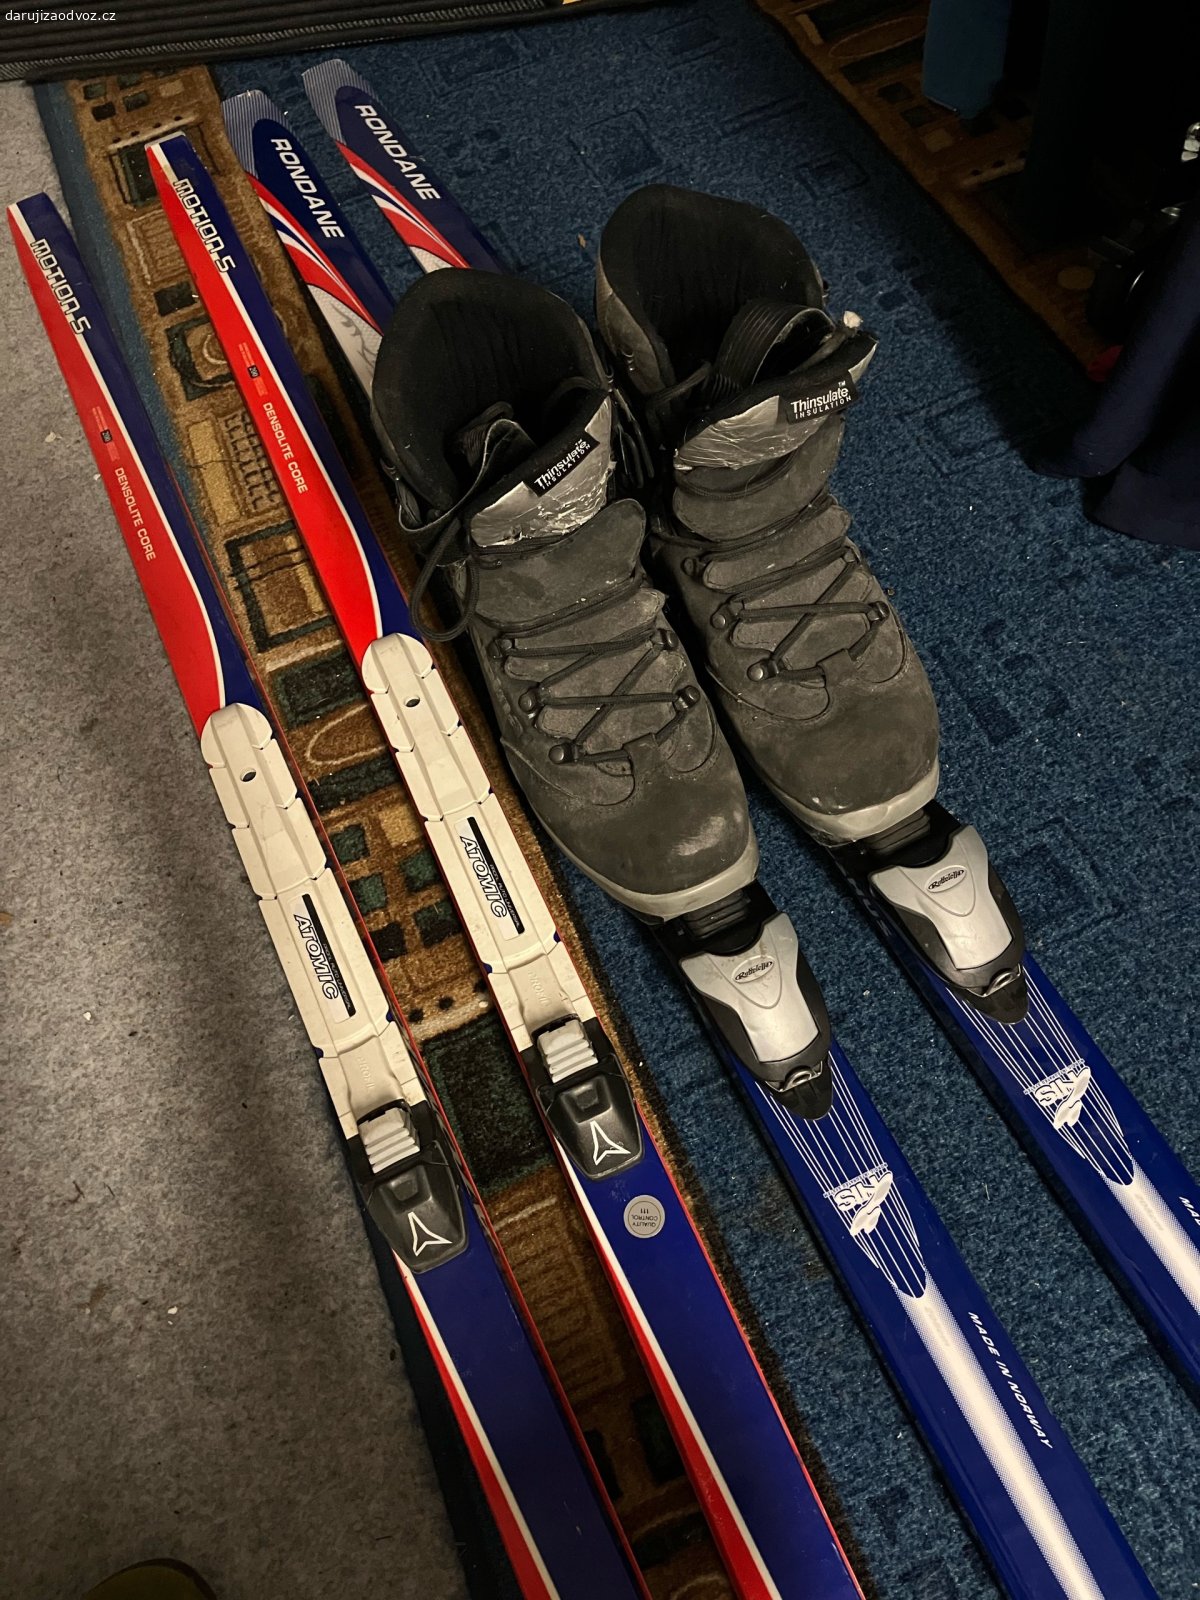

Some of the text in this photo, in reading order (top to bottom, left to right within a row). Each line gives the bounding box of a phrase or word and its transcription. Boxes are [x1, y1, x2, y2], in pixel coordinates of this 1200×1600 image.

[270, 138, 345, 238] RONDANE
[354, 104, 441, 200] RONDANE
[173, 178, 225, 254] MOTION
[30, 238, 80, 315] MOTION
[790, 387, 849, 413] Thinsulate
[795, 395, 852, 419] INSULATION
[262, 402, 308, 493] DENSOLITE CORE
[533, 441, 587, 487] Thinsulate
[542, 443, 591, 490] INSULATION
[114, 467, 156, 561] DENSOLITE CORE
[459, 836, 507, 918] ATOMIC
[293, 914, 339, 1000] ATOMIC
[968, 1311, 1053, 1449] MADE IN NORWAY
